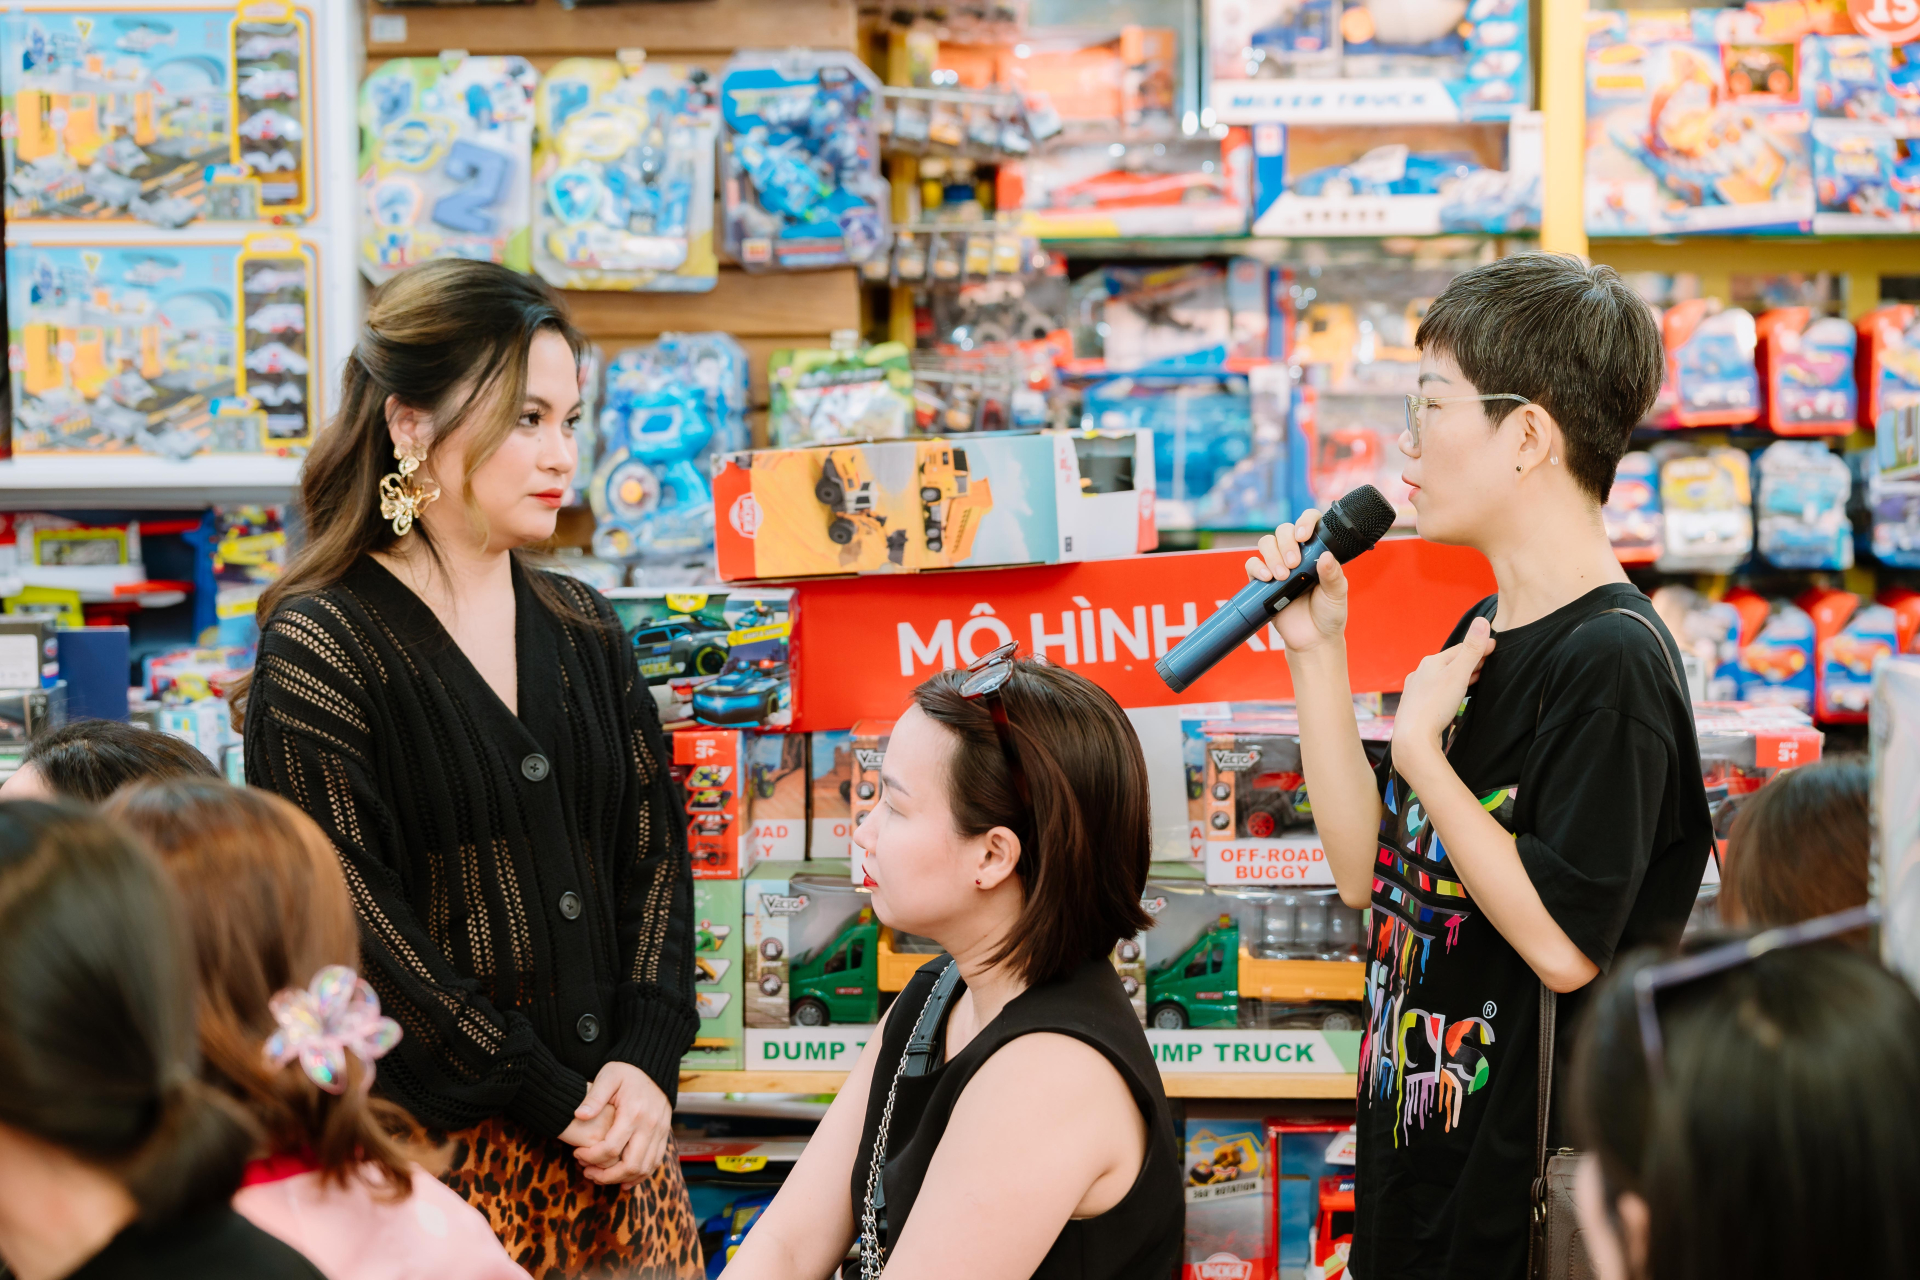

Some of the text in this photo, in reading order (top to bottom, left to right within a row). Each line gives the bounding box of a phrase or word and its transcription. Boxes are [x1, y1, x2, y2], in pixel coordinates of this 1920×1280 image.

[897, 602, 1014, 677] MÔ
[1030, 595, 1199, 666] HÌNH
[1220, 848, 1324, 862] OFF-ROAD
[1235, 865, 1309, 879] BUGGY
[763, 1042, 845, 1060] DUMP
[1151, 1044, 1314, 1062] MP TRUCK
